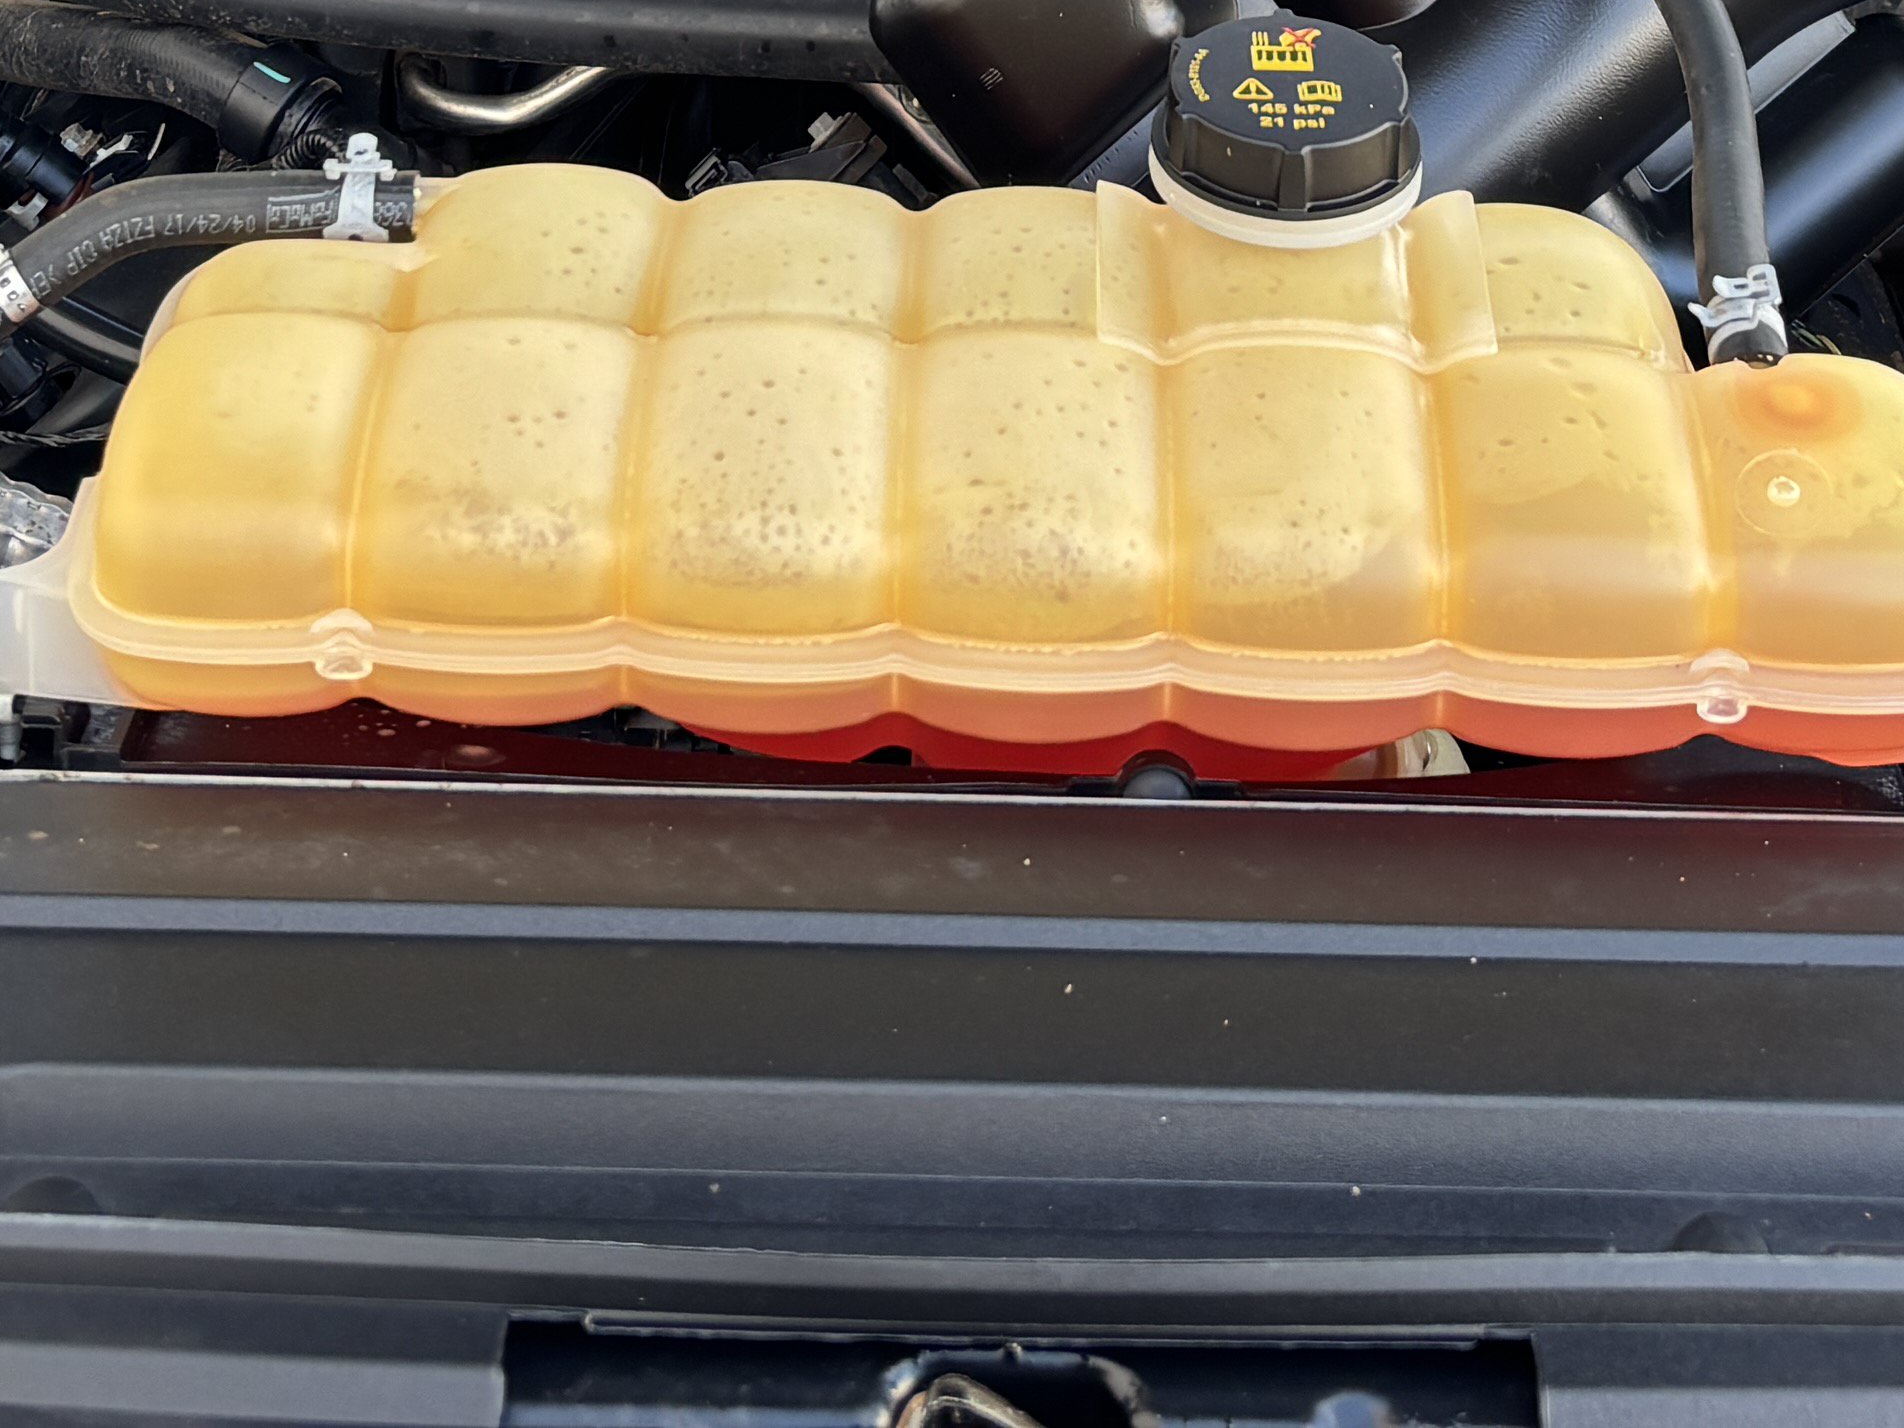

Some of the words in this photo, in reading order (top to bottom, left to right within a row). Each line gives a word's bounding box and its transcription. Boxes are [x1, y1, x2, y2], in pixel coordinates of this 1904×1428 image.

[1247, 102, 1288, 115] 145
[1293, 102, 1336, 116] kPa
[1259, 116, 1286, 129] 21
[1292, 116, 1326, 131] psi
[162, 212, 257, 236] 04/24/17
